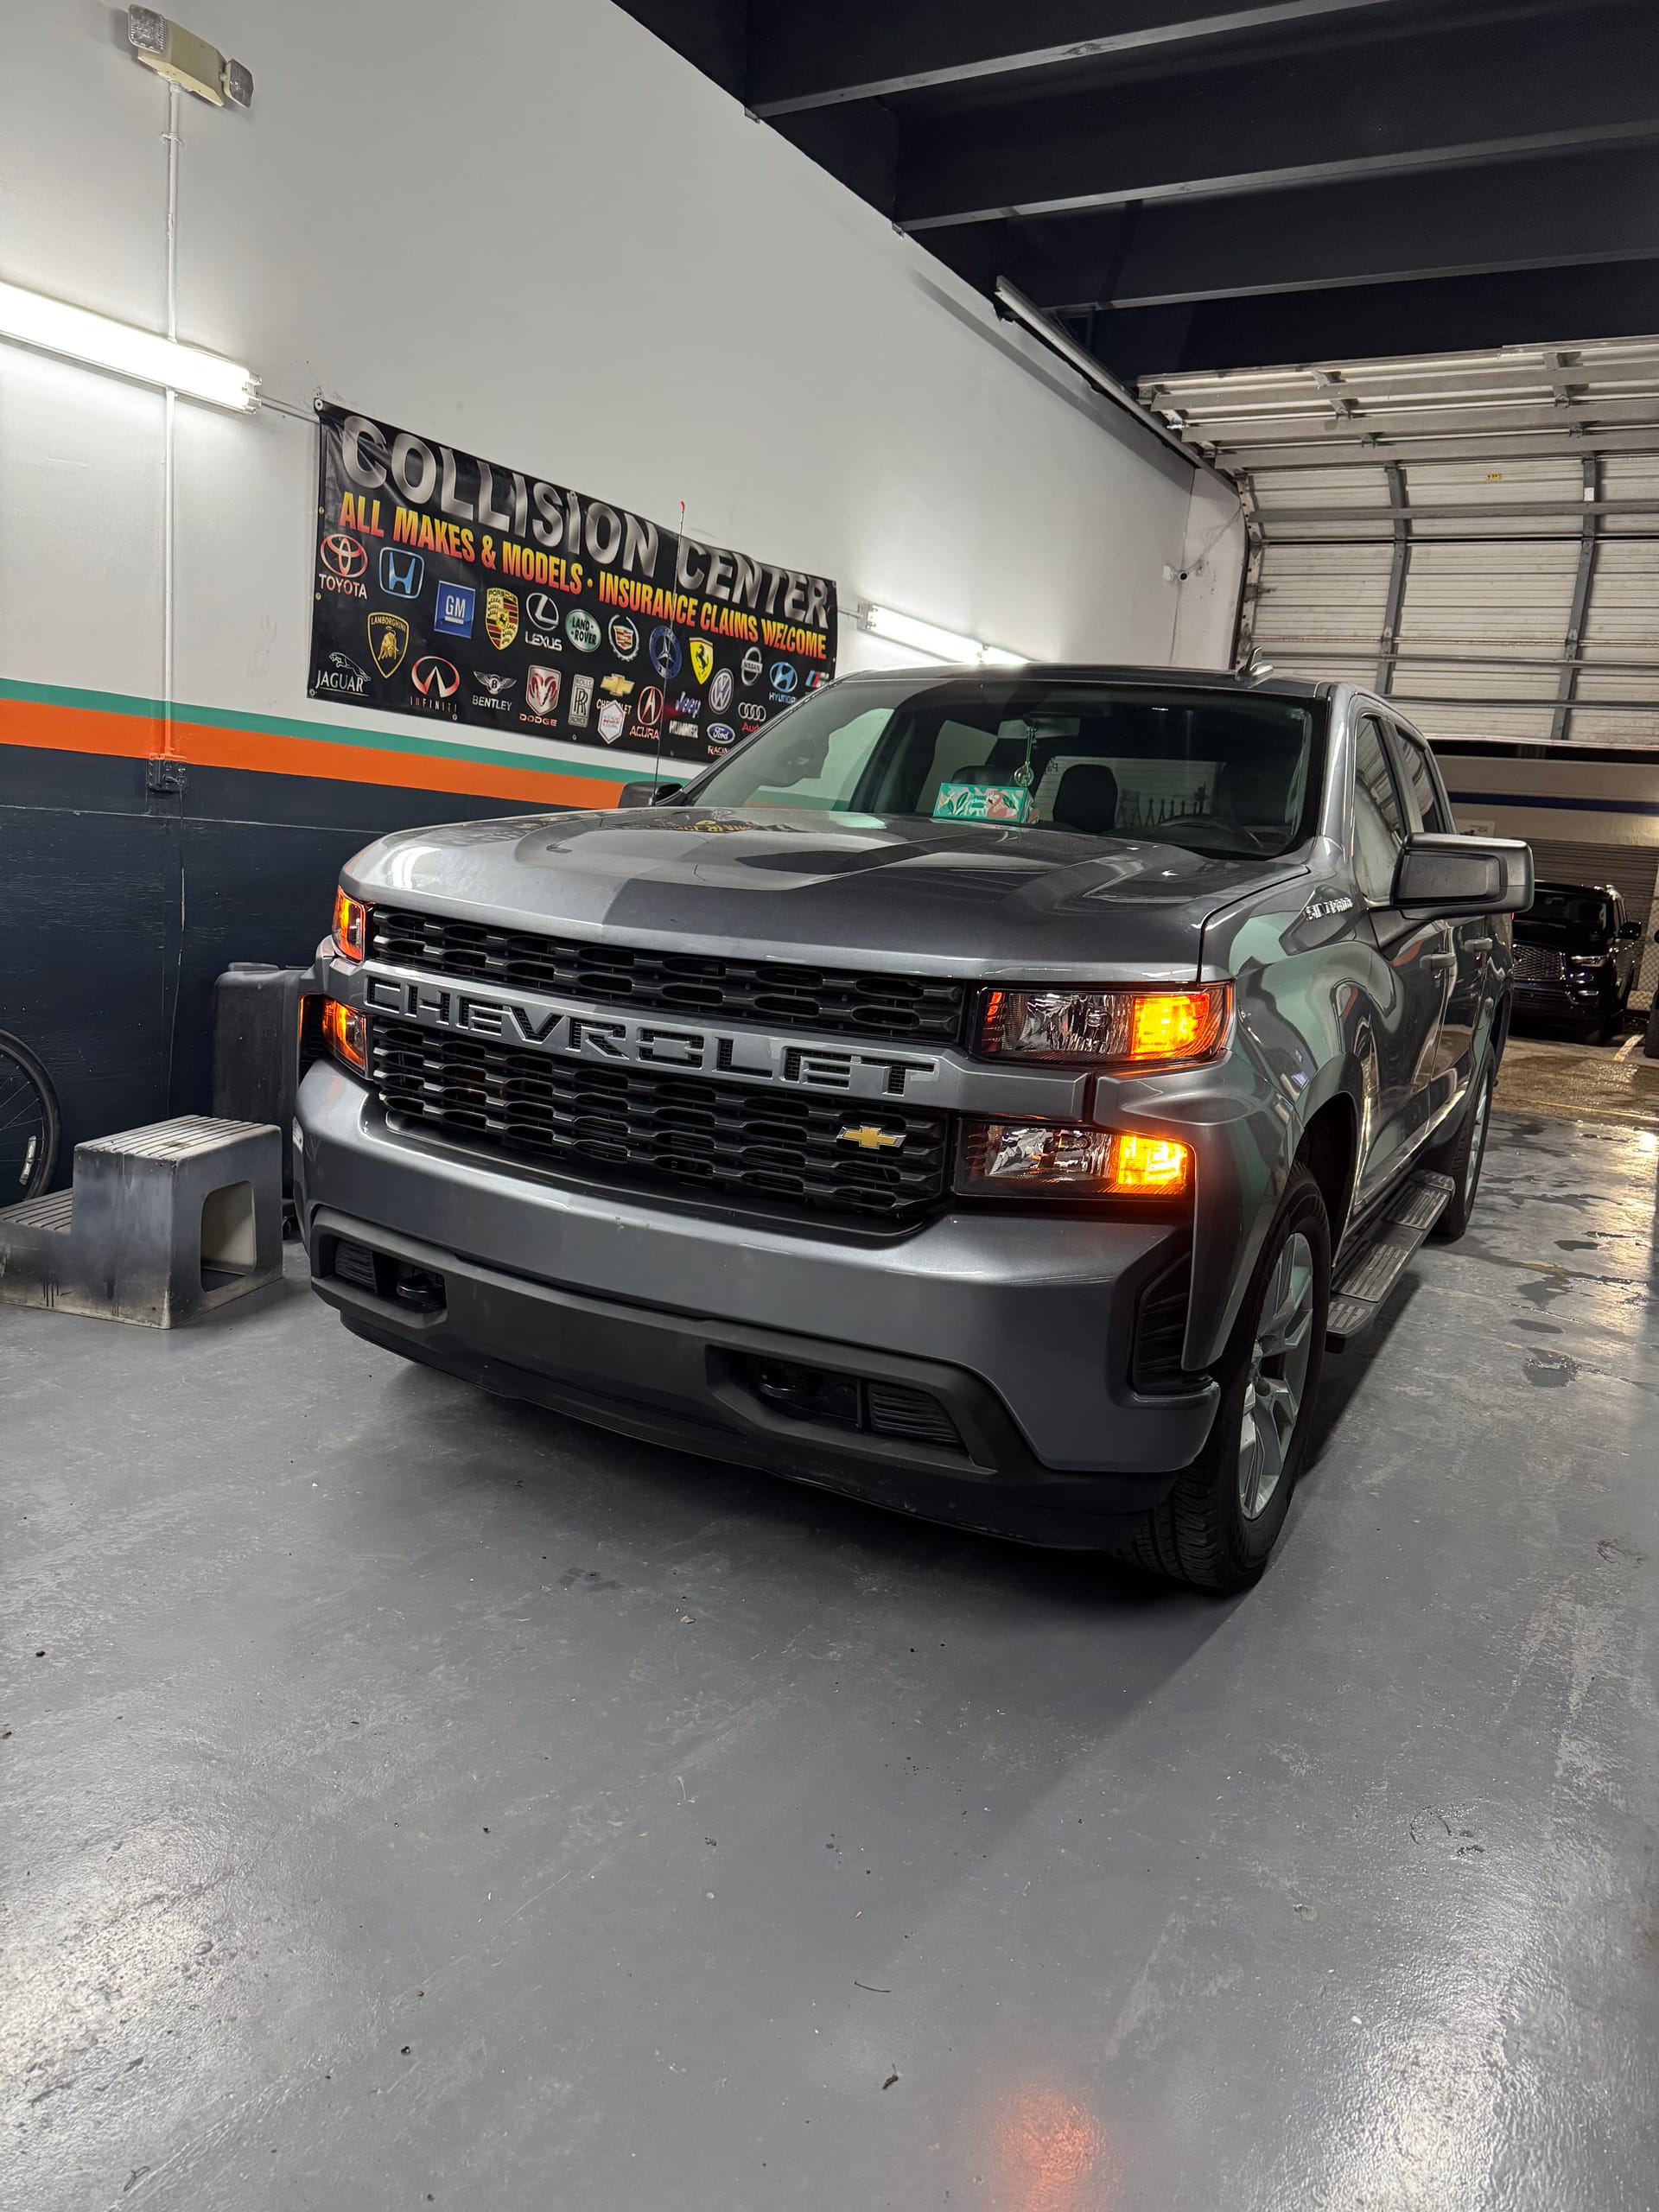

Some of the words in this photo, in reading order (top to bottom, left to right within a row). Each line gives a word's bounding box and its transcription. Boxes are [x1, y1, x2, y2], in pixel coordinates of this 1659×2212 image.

[342, 416, 658, 578] COLLISION
[677, 537, 830, 629] CENTER
[339, 491, 385, 538] ALL
[393, 507, 475, 563] MAKES
[481, 535, 497, 571] &
[503, 541, 582, 595] MODELS
[599, 571, 698, 627] INSURANCE
[700, 601, 759, 644] CLAIMS
[761, 618, 826, 660] WELCOME
[319, 573, 368, 600] TOYOTA
[445, 594, 467, 619] GM
[371, 615, 407, 632] LAMBORGHINI
[572, 616, 591, 631] LAND
[524, 631, 563, 652] LEXUS
[574, 631, 597, 645] ROVER
[744, 661, 760, 671] NISSAN
[315, 670, 364, 693] JAGUAR
[410, 696, 457, 713] INFINITI
[472, 694, 512, 712] BENTLEY
[675, 690, 702, 719] Jeep
[519, 713, 558, 727] DODGE
[741, 721, 760, 733] Aud
[629, 725, 660, 741] ACURA
[669, 719, 699, 739] HUMMER
[713, 726, 729, 741] Ford
[707, 745, 730, 756] RACIN
[365, 975, 938, 1096] CHEVROLET
